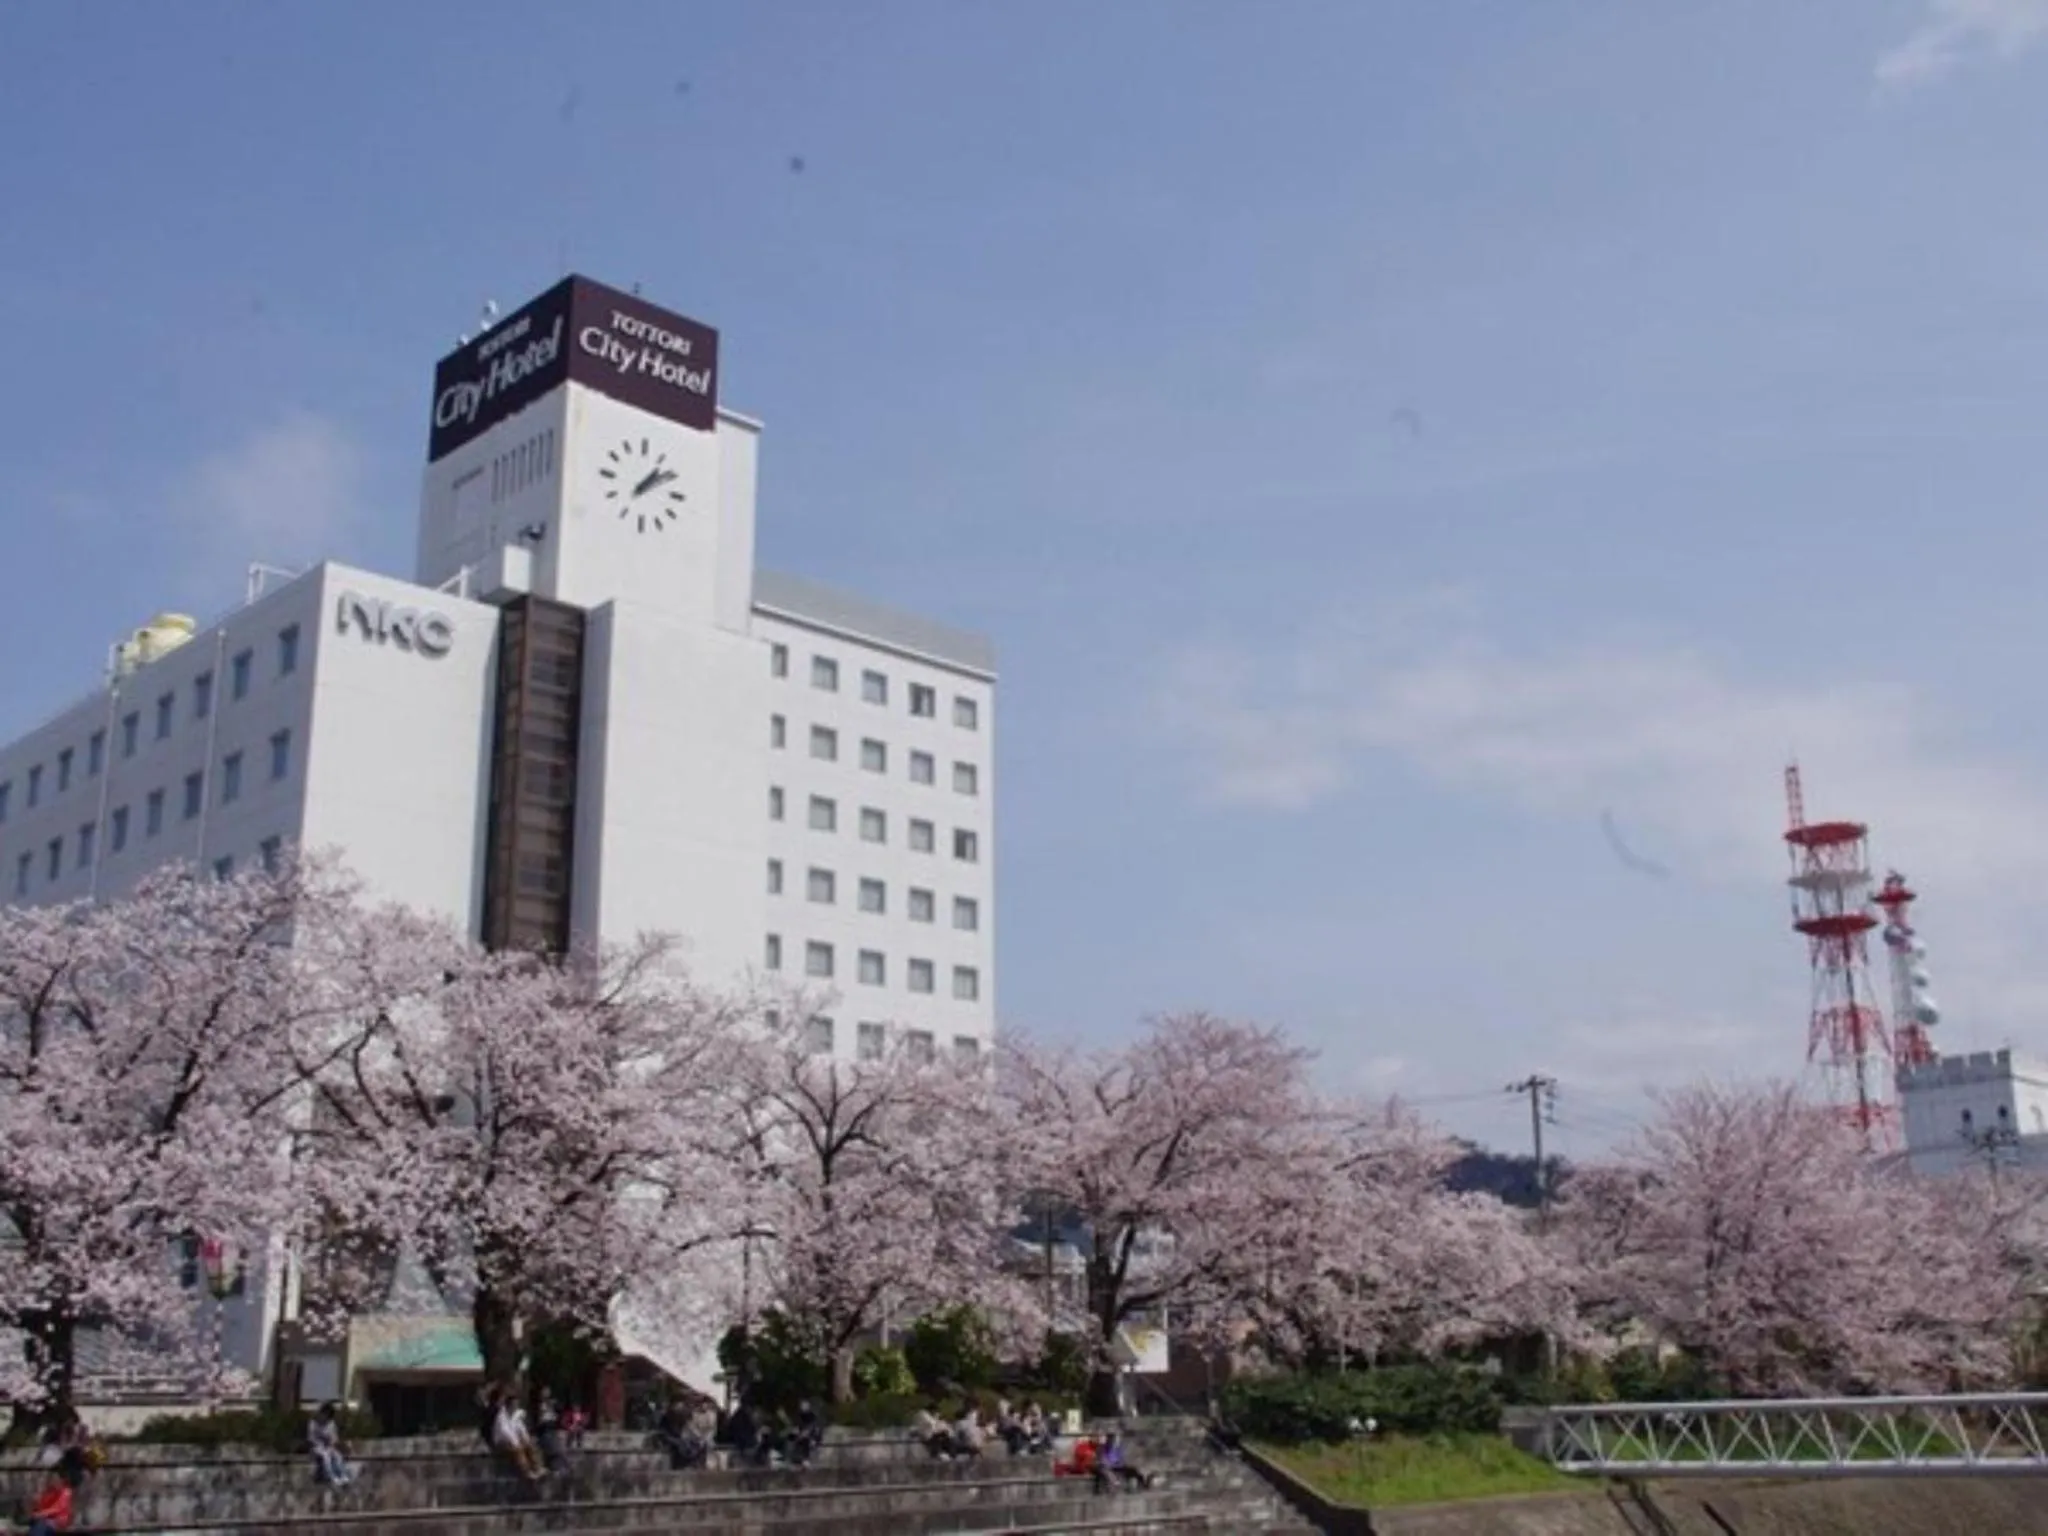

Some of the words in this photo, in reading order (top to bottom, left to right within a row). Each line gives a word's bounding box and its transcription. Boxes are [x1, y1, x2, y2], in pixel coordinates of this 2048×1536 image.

[436, 377, 485, 428] City
[486, 314, 564, 399] Hotel
[579, 326, 637, 374] City
[637, 346, 712, 395] Hotel
